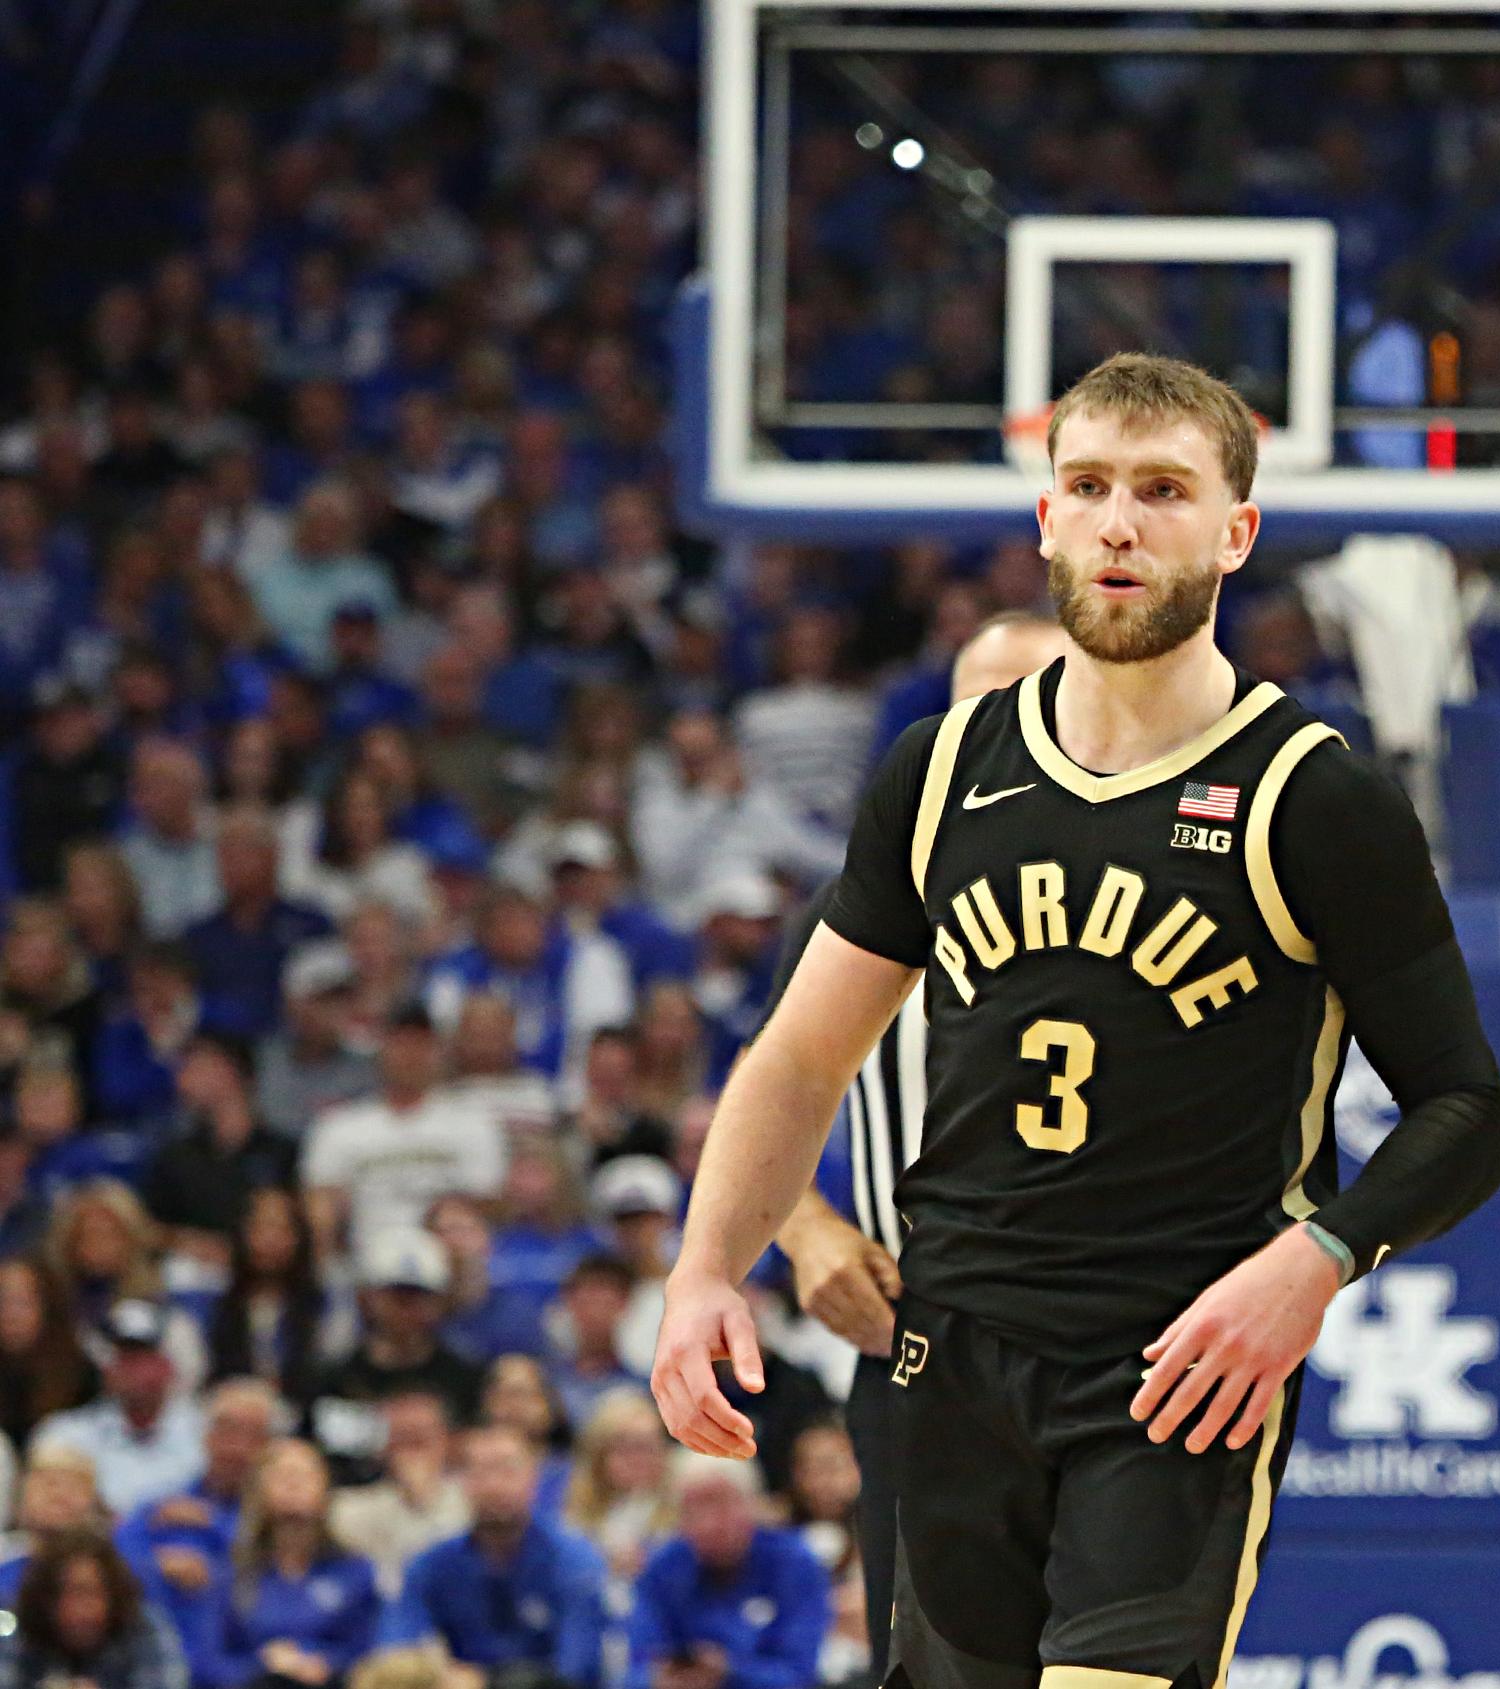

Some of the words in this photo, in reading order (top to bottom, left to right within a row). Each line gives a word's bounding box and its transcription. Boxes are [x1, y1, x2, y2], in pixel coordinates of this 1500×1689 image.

[934, 861, 1259, 1030] PURDUE
[1015, 1018, 1096, 1154] 3
[891, 1329, 929, 1387] P
